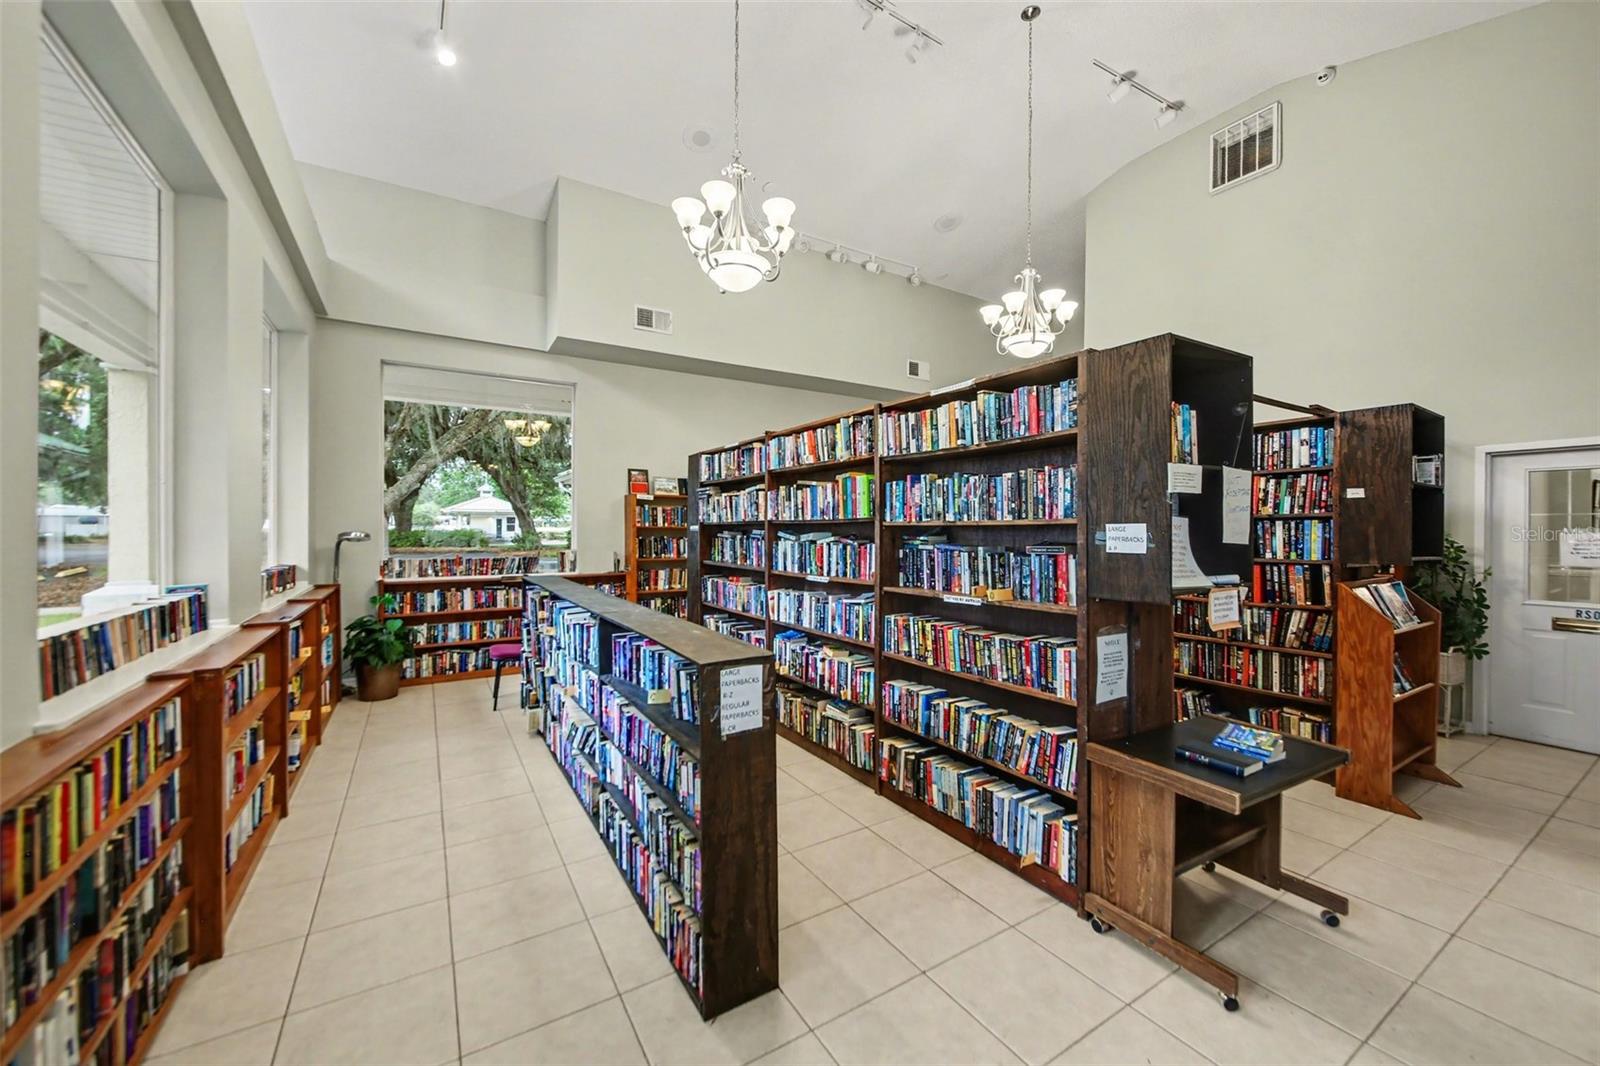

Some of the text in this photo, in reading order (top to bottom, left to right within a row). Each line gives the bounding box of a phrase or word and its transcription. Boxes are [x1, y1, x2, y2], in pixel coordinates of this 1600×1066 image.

[1108, 535, 1145, 543] PAPERBACKS
[721, 669, 741, 677] LARGE
[721, 678, 760, 687] PAPERBACKS
[722, 700, 750, 711] REGULAR
[722, 710, 760, 721] PAPERBACKS
